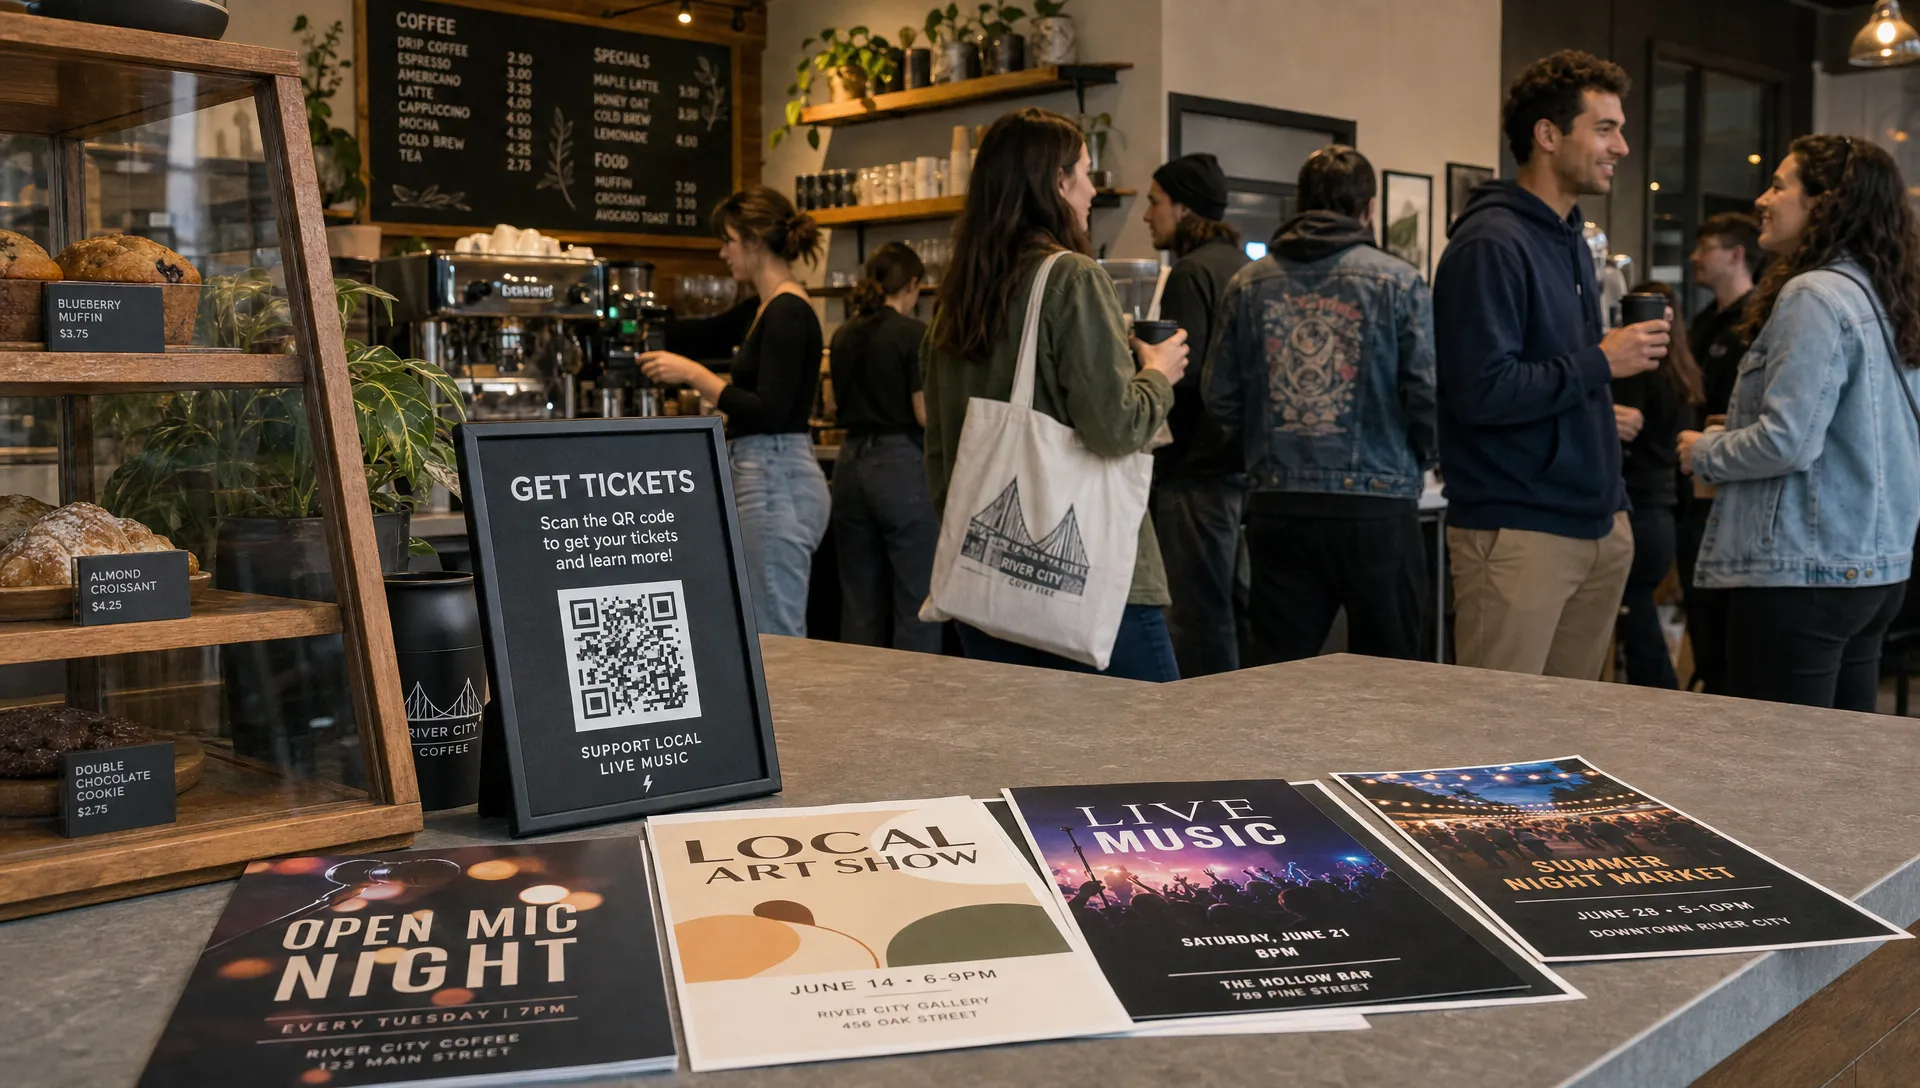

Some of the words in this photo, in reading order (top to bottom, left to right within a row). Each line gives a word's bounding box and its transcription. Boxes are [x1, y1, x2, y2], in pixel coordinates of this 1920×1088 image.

[396, 11, 456, 35] COFFEE
[397, 36, 424, 50] DRIP
[427, 40, 468, 57] COFFEE
[507, 51, 532, 65] 2.50
[594, 47, 650, 69] SPECIALS
[397, 52, 451, 70] ESPRESSO
[507, 66, 532, 80] 3.00
[398, 68, 461, 87] AMERICANO
[507, 81, 532, 95] 3.25
[398, 85, 434, 99] LATTE
[594, 73, 626, 89] MAPLE
[629, 78, 659, 93] LATTE
[594, 92, 627, 107] HONEY
[629, 97, 649, 110] OAT
[398, 100, 470, 119] CAPPUCCINO
[506, 111, 532, 125] 4.00
[594, 110, 620, 123] COLD
[623, 112, 651, 126] BREW
[399, 116, 439, 131] MOCHA
[506, 126, 532, 140] 4.50
[594, 126, 648, 144] LEMONADE
[399, 133, 429, 147] COLD
[433, 136, 465, 150] BREW
[506, 142, 532, 156] 4.25
[399, 149, 423, 162] TEA
[507, 158, 532, 172] 2.75
[595, 152, 628, 169] FOOD
[595, 175, 632, 189] MUFFIN
[595, 209, 640, 223] AVOCADO
[58, 299, 121, 309] BLUEBERRY
[59, 313, 103, 322] MUFFIN
[60, 329, 89, 339] $3.75
[511, 474, 570, 501] GET
[579, 469, 695, 498] TICKETS
[540, 515, 579, 530] Scan
[582, 513, 608, 527] the
[612, 511, 635, 526] QR
[639, 509, 675, 524] code
[543, 537, 560, 550] to
[564, 536, 590, 552] get
[594, 534, 627, 550] your
[631, 529, 678, 545] tickets
[556, 555, 585, 570] and
[589, 553, 626, 567] learn
[631, 548, 673, 565] more!
[90, 569, 141, 582] ALMOND
[1001, 557, 1035, 578] RIVER
[1036, 568, 1063, 586] CITY
[90, 581, 157, 595] CROISSANT
[92, 600, 122, 612] $4.25
[409, 726, 448, 738] RIVER
[453, 722, 477, 735] CITY
[420, 743, 469, 757] COFFEE
[581, 738, 650, 759] SUPPORT
[655, 732, 702, 749] LOCAL
[75, 761, 124, 776] DOUBLE
[600, 759, 635, 775] LIVE
[641, 751, 689, 770] MUSIC
[76, 770, 151, 789] CHOCOLATE
[76, 787, 125, 801] COOKIE
[78, 804, 108, 818] $2.75
[1075, 798, 1272, 827] LIVE
[684, 825, 976, 865] LOCAL
[1093, 822, 1286, 854] MUSIC
[705, 859, 817, 885] ART
[834, 850, 977, 875] SHOW
[1531, 855, 1670, 873] SUMMER
[1502, 874, 1603, 891] NIGHT
[1607, 866, 1736, 885] MARKET
[1578, 909, 1630, 921] JUNE
[1677, 901, 1755, 914] 5-10PM
[282, 912, 434, 950] OPEN
[466, 903, 578, 940] MIC
[1181, 933, 1277, 947] SATURDAY,
[1281, 930, 1326, 942] JUNE
[1328, 928, 1350, 938] 21
[1589, 923, 1694, 938] DOWNTOWN
[1696, 920, 1750, 931] RIVER
[1752, 916, 1791, 927] CITY
[273, 937, 578, 1002] NIGHT
[1219, 978, 1256, 990] THE
[1260, 973, 1332, 988] HOLLOW
[1336, 970, 1373, 981] BAR
[790, 980, 856, 995] JUNE
[867, 978, 894, 988] 14
[923, 969, 997, 984] 6-9PM
[1232, 991, 1262, 1001] 789
[1268, 988, 1307, 998] PINE
[1309, 983, 1371, 995] STREET
[817, 1006, 867, 1019] RIVER
[873, 1003, 910, 1014] CITY
[917, 996, 990, 1010] GALLERY
[281, 1019, 363, 1034] EVERY
[378, 1009, 490, 1027] TUESDAY
[519, 1004, 565, 1016] 7PM
[842, 1020, 871, 1030] 456
[877, 1016, 911, 1027] OAK
[917, 1010, 979, 1023] STREET
[306, 1045, 372, 1059] RIVER
[380, 1040, 431, 1054] CITY
[439, 1033, 520, 1048] COFFEE
[319, 1059, 355, 1072] 123
[365, 1054, 422, 1068] MAIN
[432, 1046, 511, 1063] STREET
